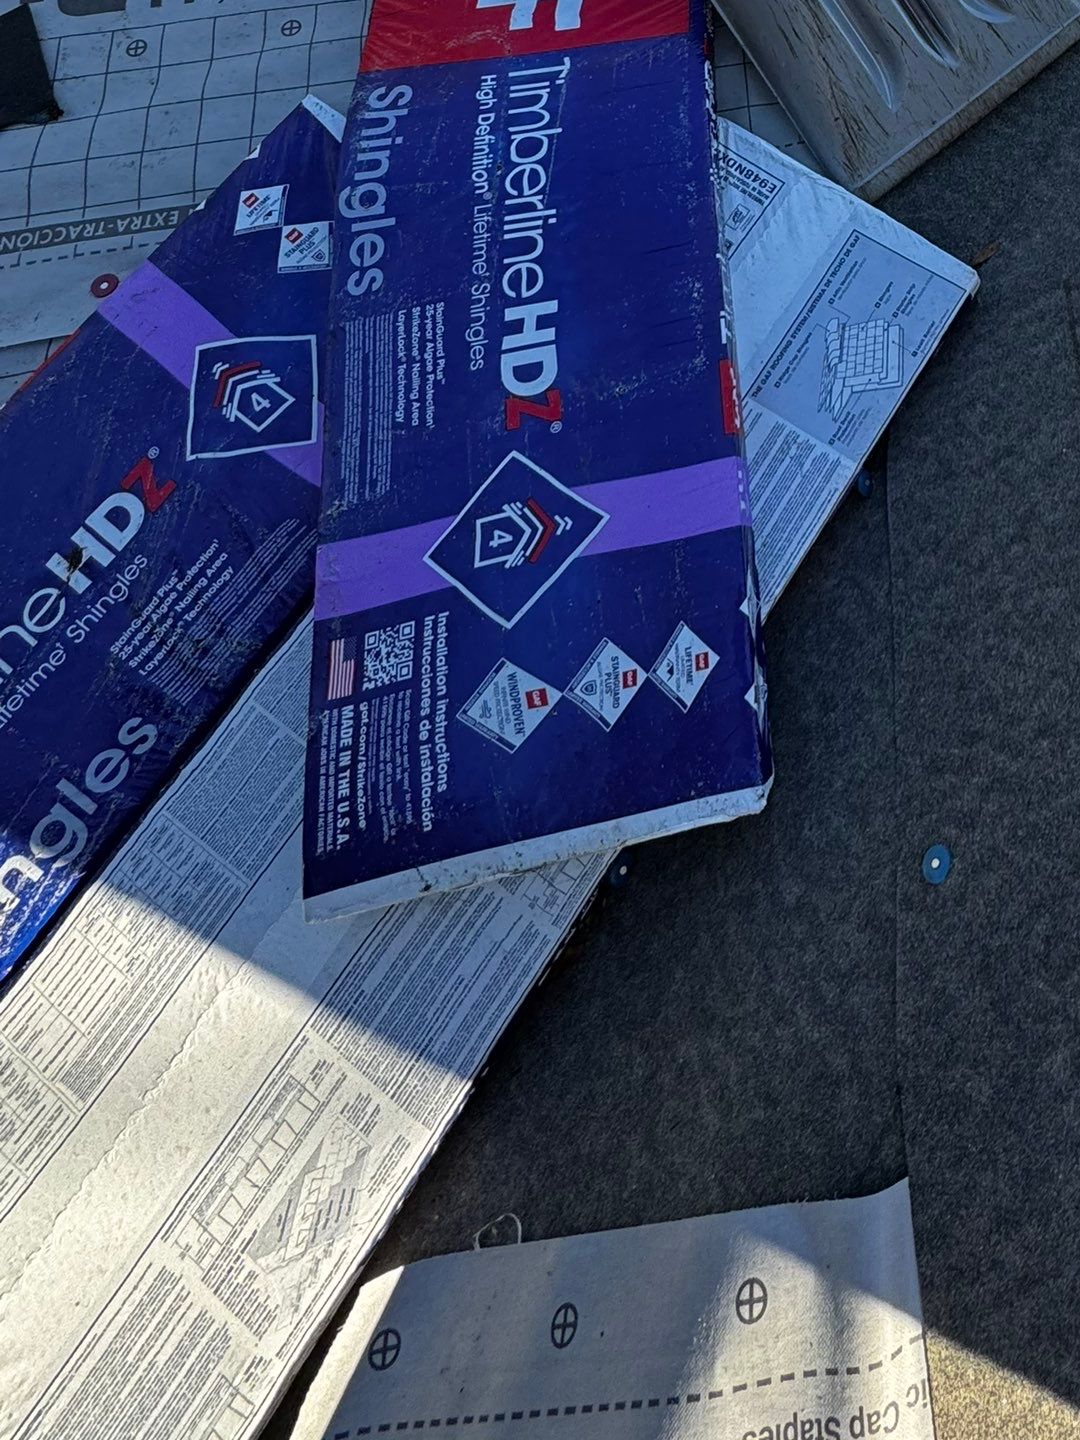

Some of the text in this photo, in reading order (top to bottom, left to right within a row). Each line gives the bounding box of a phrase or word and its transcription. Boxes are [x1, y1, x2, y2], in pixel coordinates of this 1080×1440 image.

[472, 74, 497, 110] High
[338, 84, 414, 296] Shingles
[424, 303, 435, 340] 25-year
[435, 301, 445, 358] StainGuard
[465, 281, 491, 371] Shingles
[750, 383, 763, 399] THE
[768, 338, 793, 371] ROOFING
[822, 277, 833, 289] DE
[828, 255, 847, 280] TECHO
[842, 246, 853, 258] DE
[409, 362, 421, 400] Nailing
[423, 341, 435, 372] Algae
[395, 363, 407, 423] Technology
[411, 401, 421, 427] Area
[66, 553, 149, 645] Shingles
[174, 576, 209, 613] Nailing
[206, 552, 229, 578] Area
[182, 565, 234, 622] Technology
[109, 595, 160, 655] StainGuard
[118, 621, 153, 661] 25-year
[150, 591, 178, 623] Algae
[434, 611, 451, 793] Installation instructions
[532, 690, 542, 706] GAF
[610, 655, 621, 710] STAINGUARD
[419, 615, 436, 832] Instrucciones de instalación
[318, 775, 327, 811] AMERICAN
[336, 704, 355, 850] MADE IN THE U.S.A.
[849, 1400, 900, 1440] Cap
